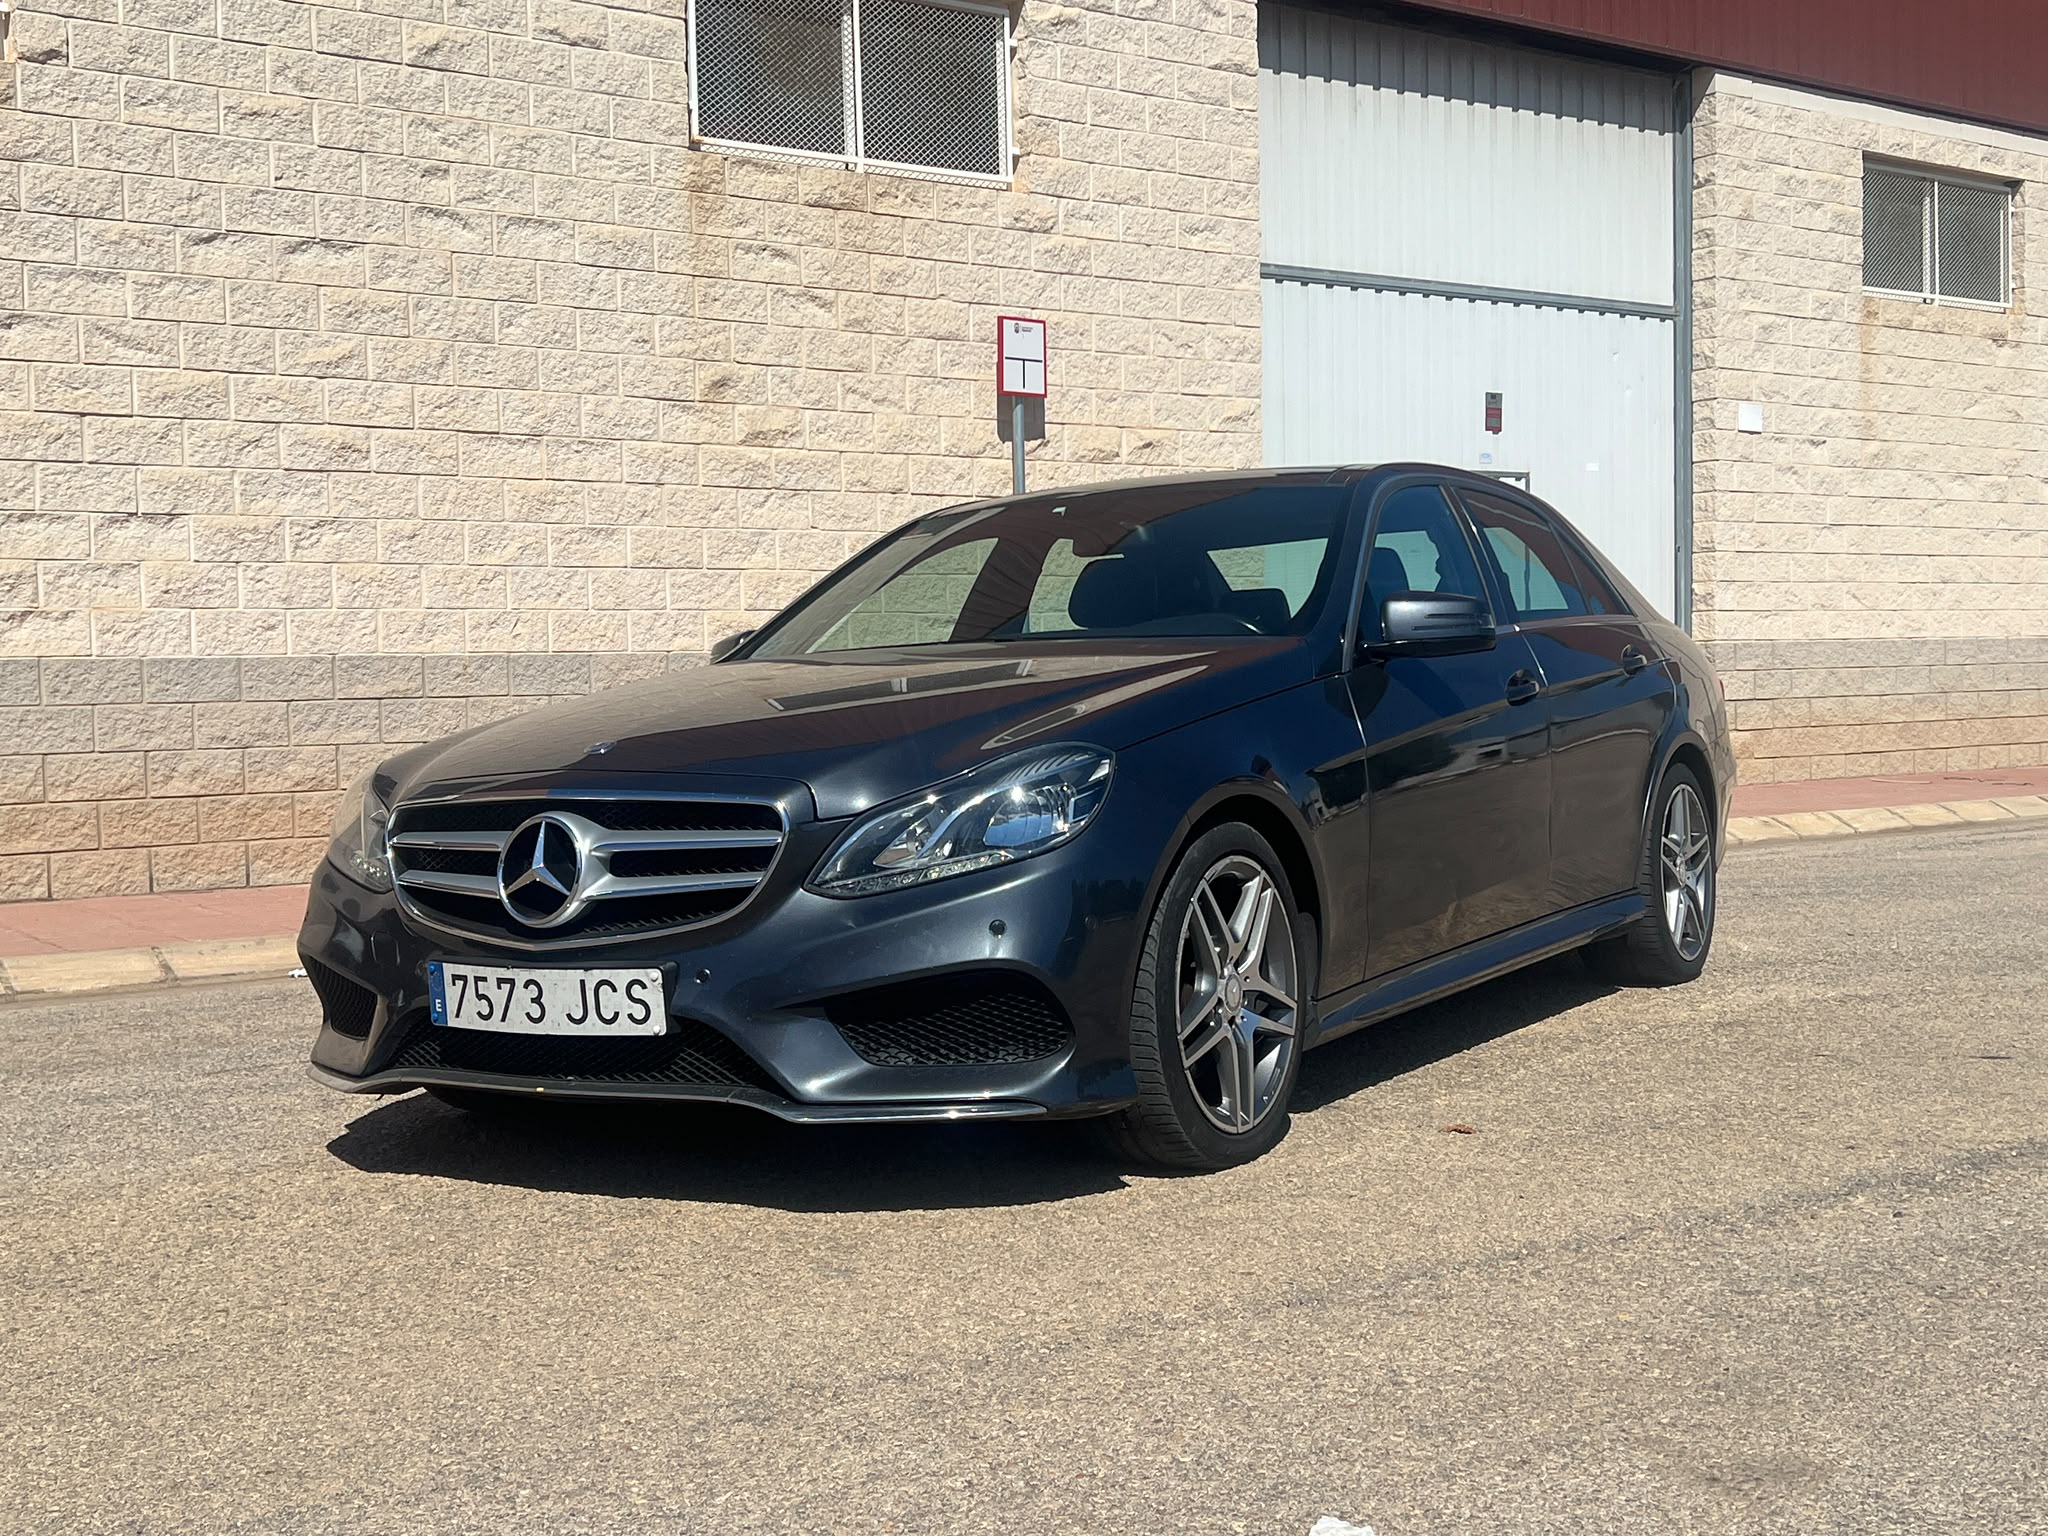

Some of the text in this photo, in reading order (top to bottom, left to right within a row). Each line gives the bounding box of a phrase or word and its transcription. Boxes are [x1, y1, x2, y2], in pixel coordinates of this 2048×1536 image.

[435, 998, 443, 1012] E
[451, 973, 652, 1026] 7573 JCS
